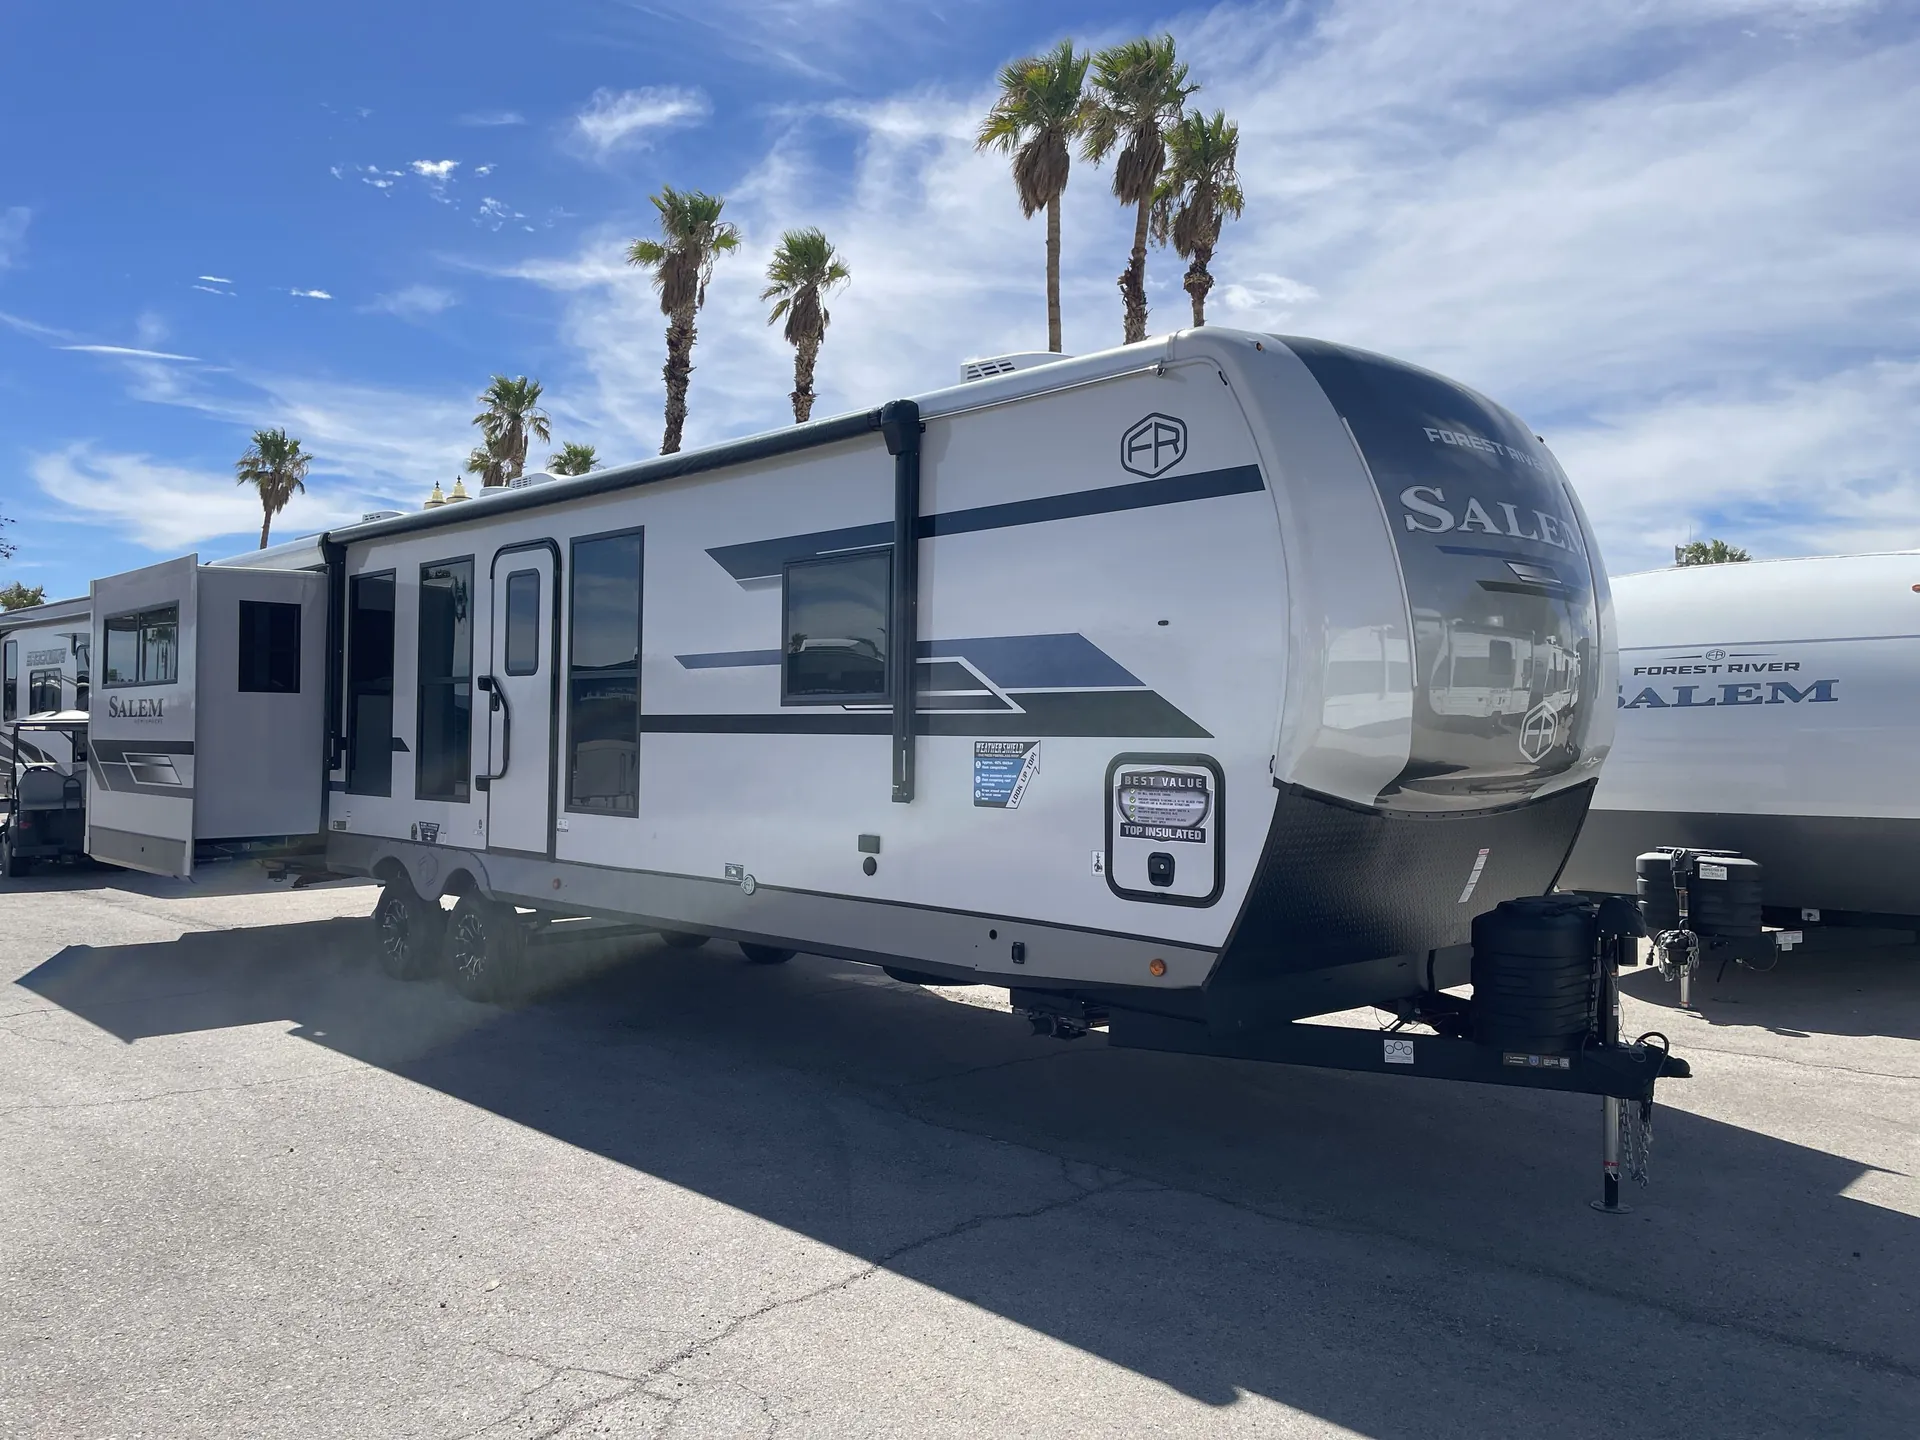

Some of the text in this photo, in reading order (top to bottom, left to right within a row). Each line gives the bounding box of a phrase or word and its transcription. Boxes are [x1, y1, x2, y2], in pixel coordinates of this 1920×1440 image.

[1423, 427, 1504, 455] FOREST
[1633, 662, 1801, 676] FOREST RIVER
[109, 695, 164, 718] SALEM
[1011, 785, 1023, 805] LOOK
[1020, 771, 1028, 783] UP
[1124, 775, 1203, 788] BEST VALUE
[1124, 825, 1202, 840] TOP INSULATED
